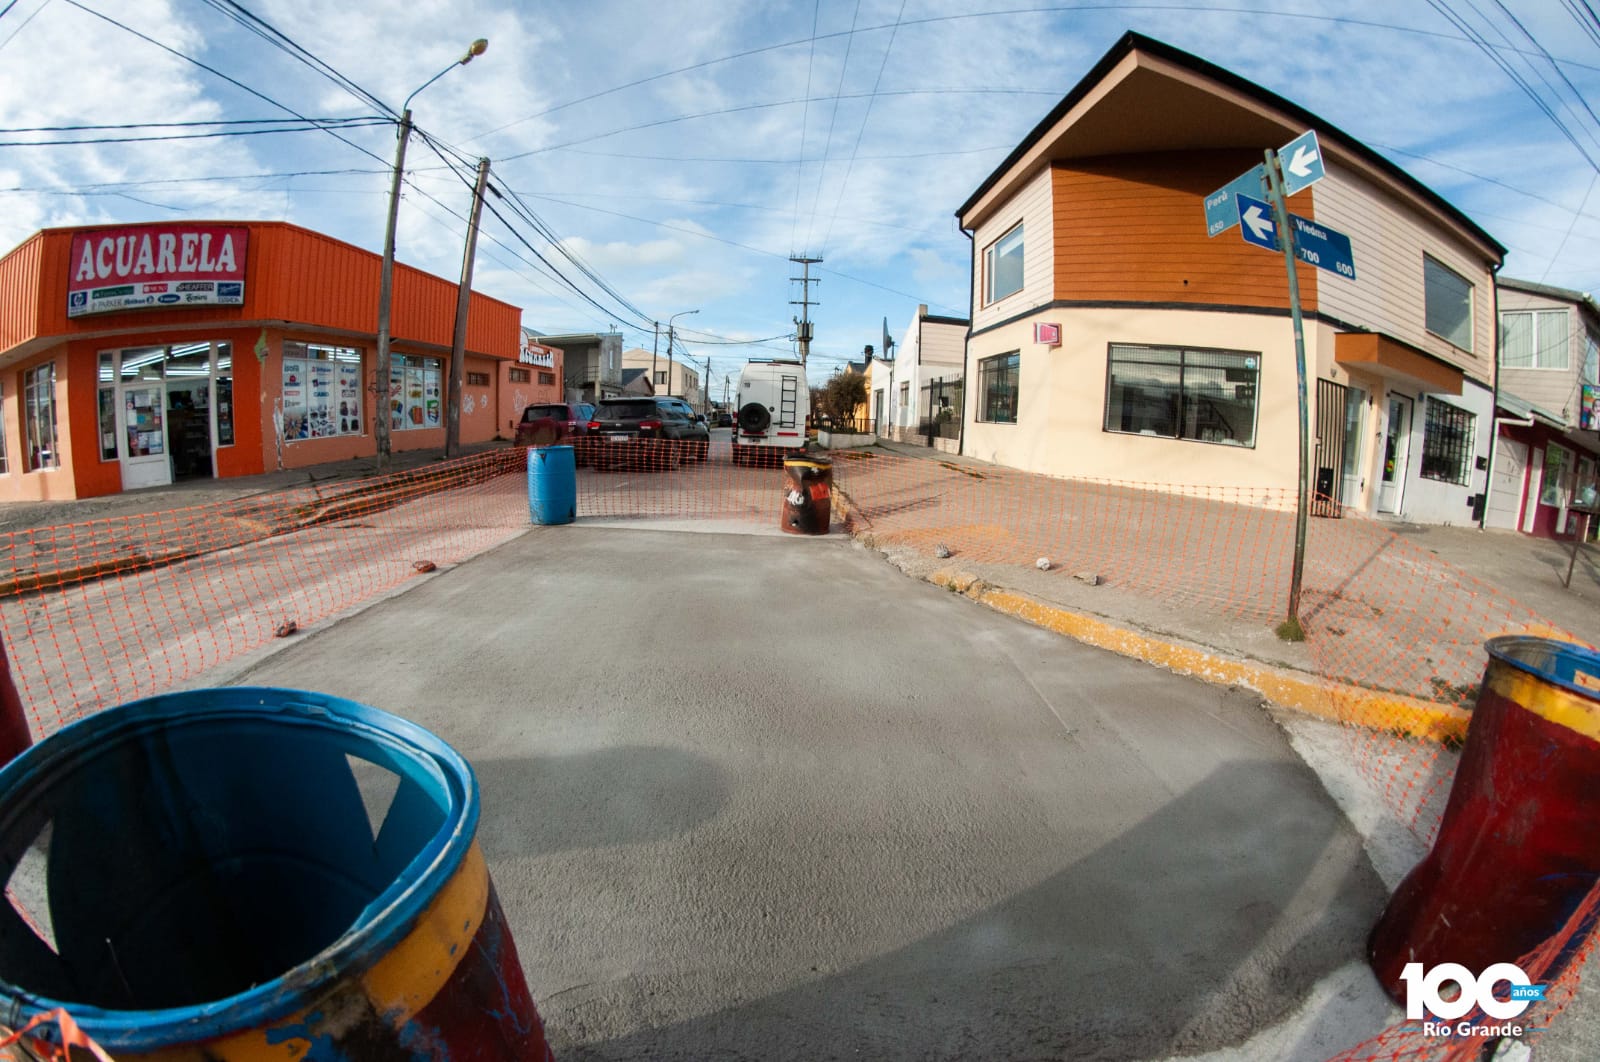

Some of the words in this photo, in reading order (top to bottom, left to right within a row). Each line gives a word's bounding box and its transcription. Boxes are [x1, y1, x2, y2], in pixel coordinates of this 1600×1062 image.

[1207, 191, 1228, 210] Perú
[1295, 218, 1327, 240] Viedma
[76, 233, 237, 282] ACUARELA
[1300, 247, 1320, 264] 700
[1335, 261, 1353, 277] 600
